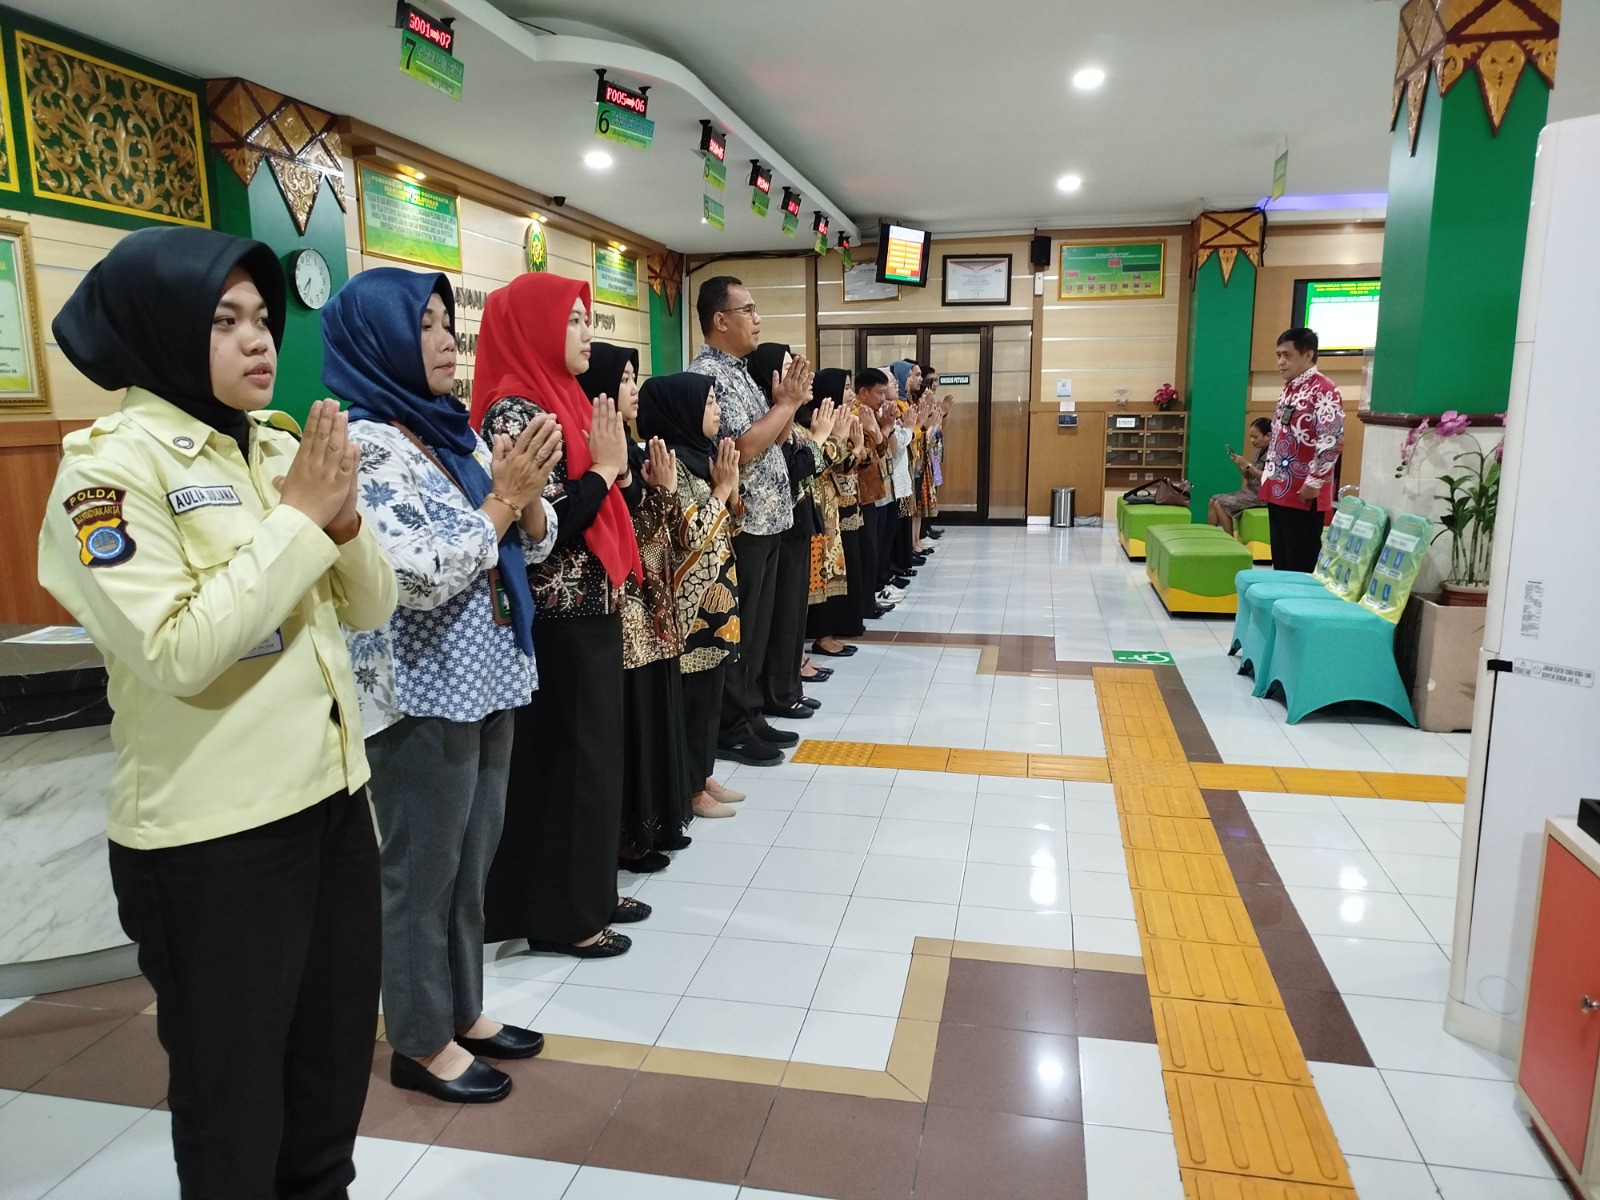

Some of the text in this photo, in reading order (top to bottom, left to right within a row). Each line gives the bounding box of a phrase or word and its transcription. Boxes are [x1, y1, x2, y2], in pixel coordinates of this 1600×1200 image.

[405, 37, 416, 70] 7
[606, 87, 645, 112] F005 06
[599, 110, 610, 134] 6
[69, 489, 117, 507] POLDA
[175, 490, 207, 509] AULIA
